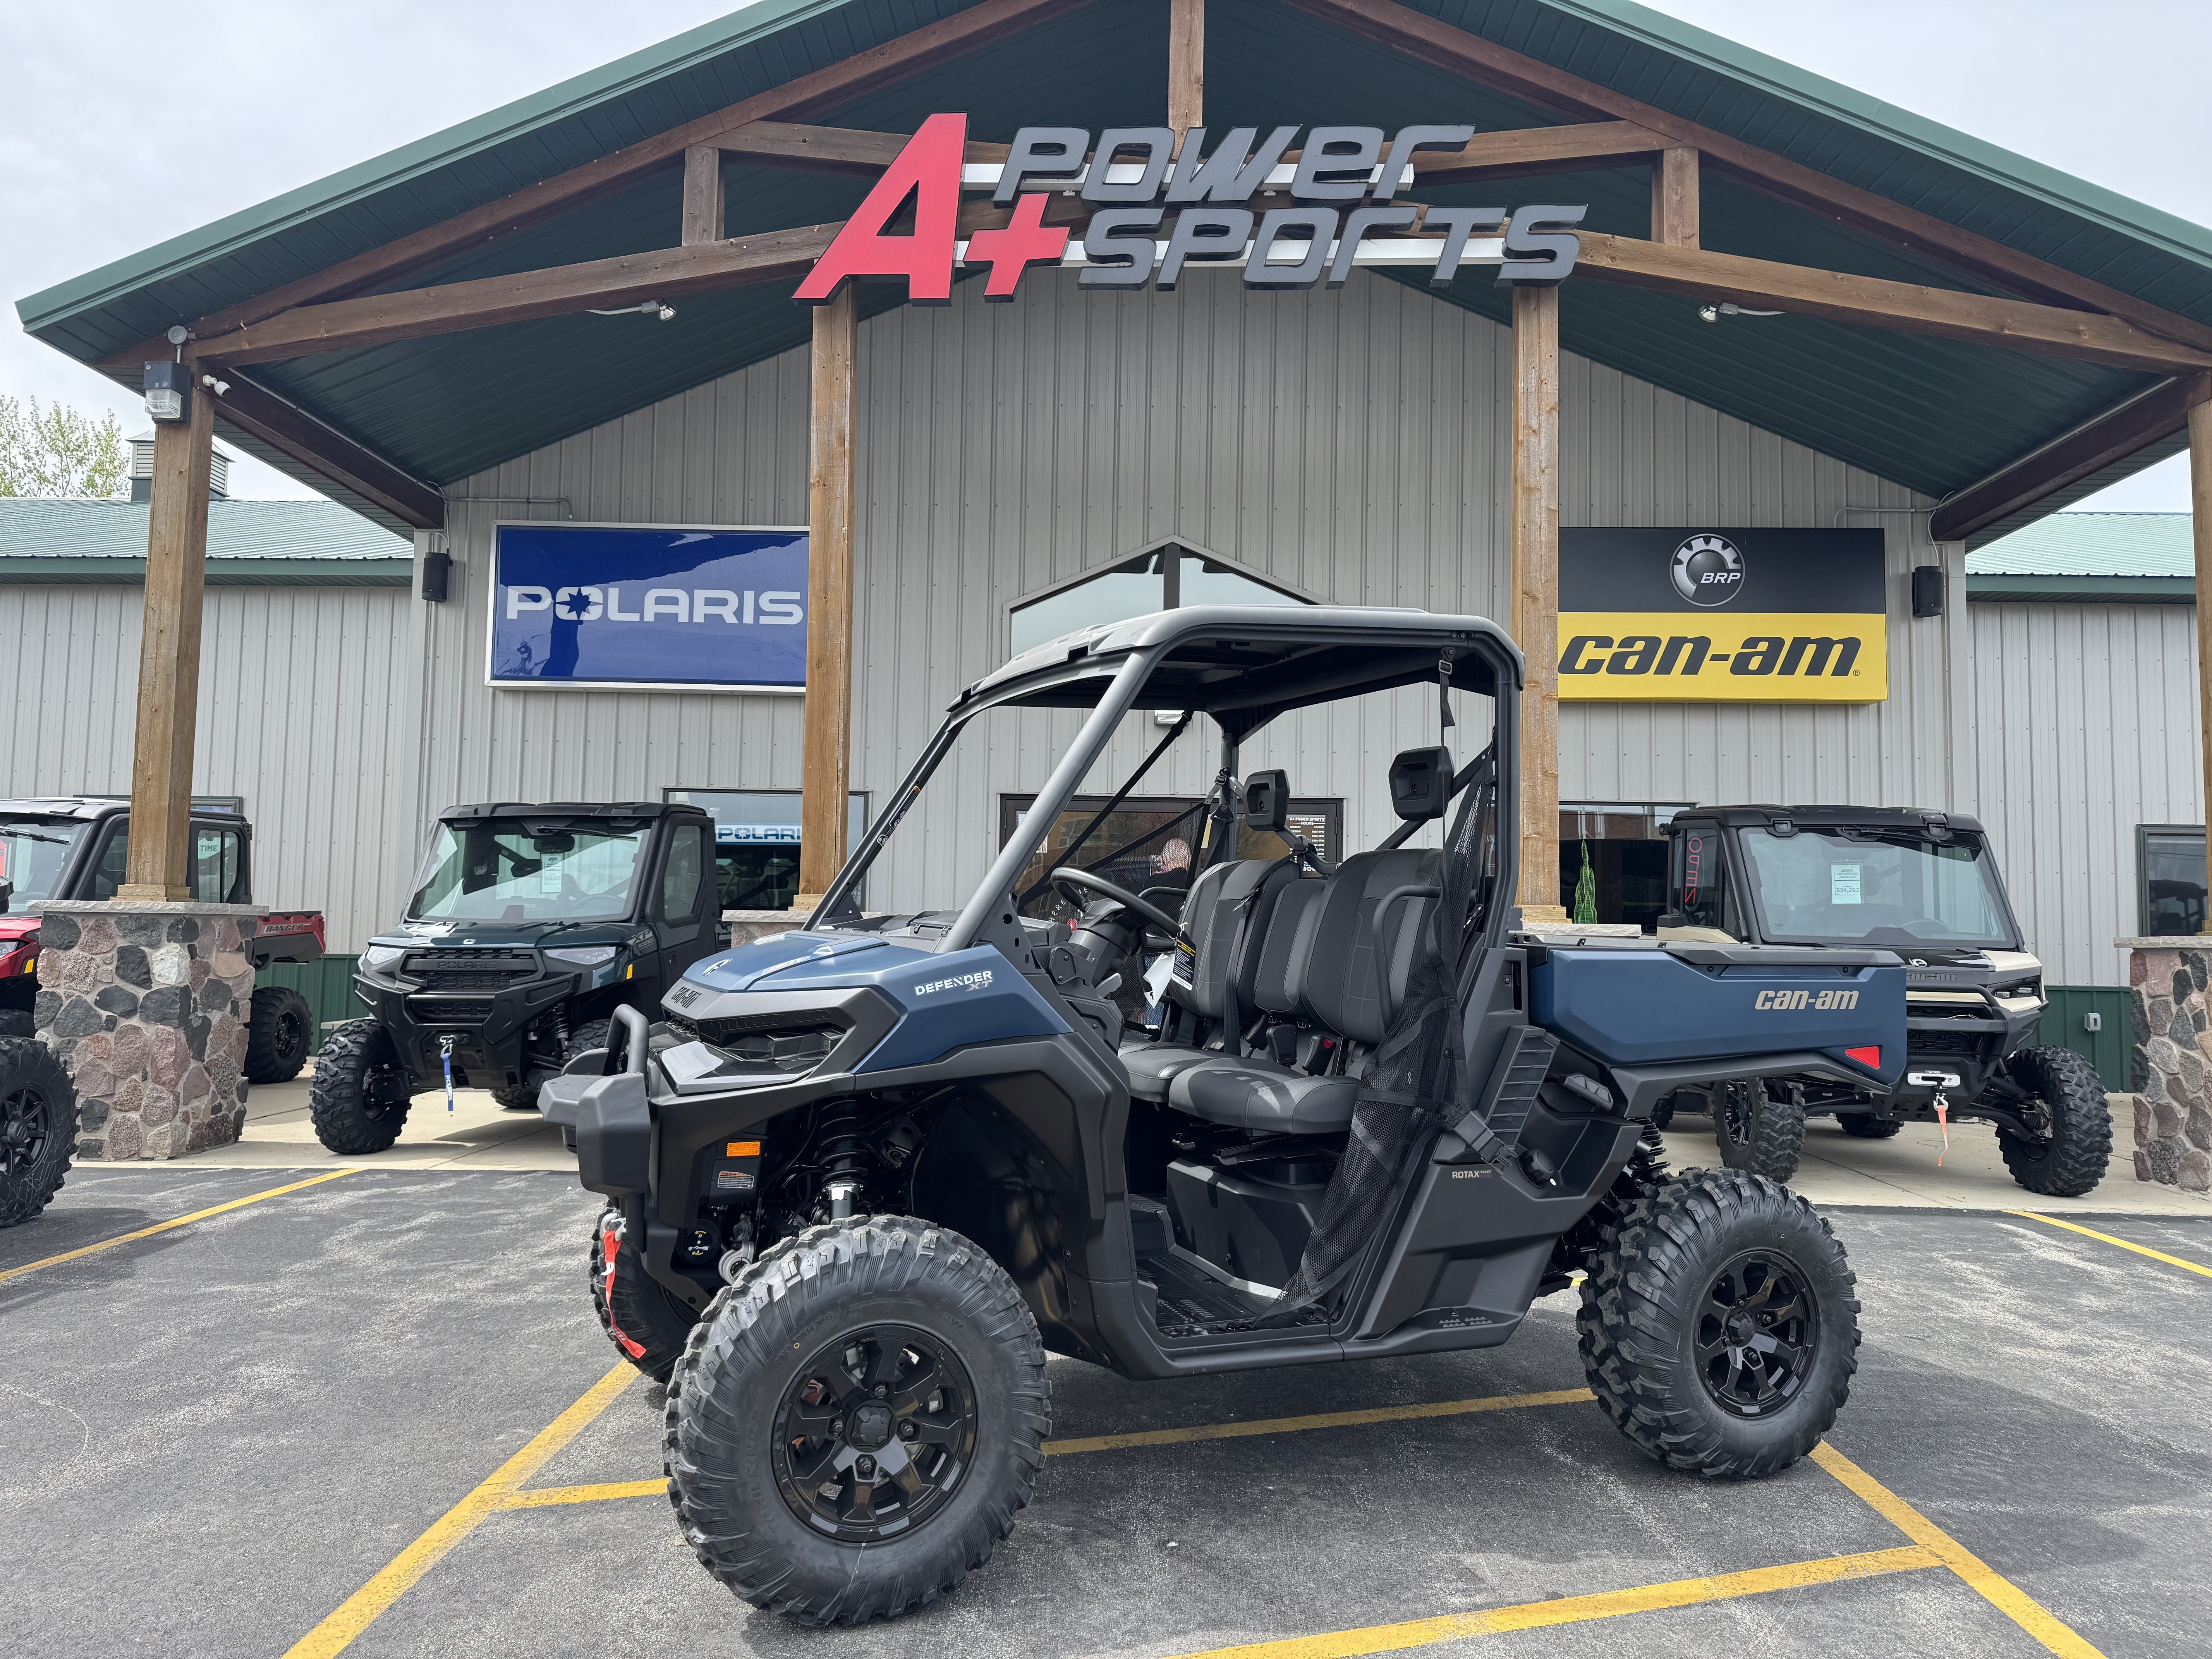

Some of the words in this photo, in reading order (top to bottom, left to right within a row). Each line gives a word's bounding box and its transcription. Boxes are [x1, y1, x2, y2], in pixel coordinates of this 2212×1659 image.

[1700, 572, 1741, 584] BRP
[507, 586, 803, 625] POLARIS
[1558, 635, 1861, 676] can-am
[718, 828, 800, 840] POLARI
[265, 924, 304, 933] RANGER
[631, 929, 651, 944] XP
[639, 938, 653, 948] 1000
[915, 970, 993, 996] DEFENDER
[1906, 972, 1956, 982] an-am
[967, 979, 993, 991] XT
[1755, 991, 1859, 1010] can-am
[816, 1312, 833, 1326] NHS
